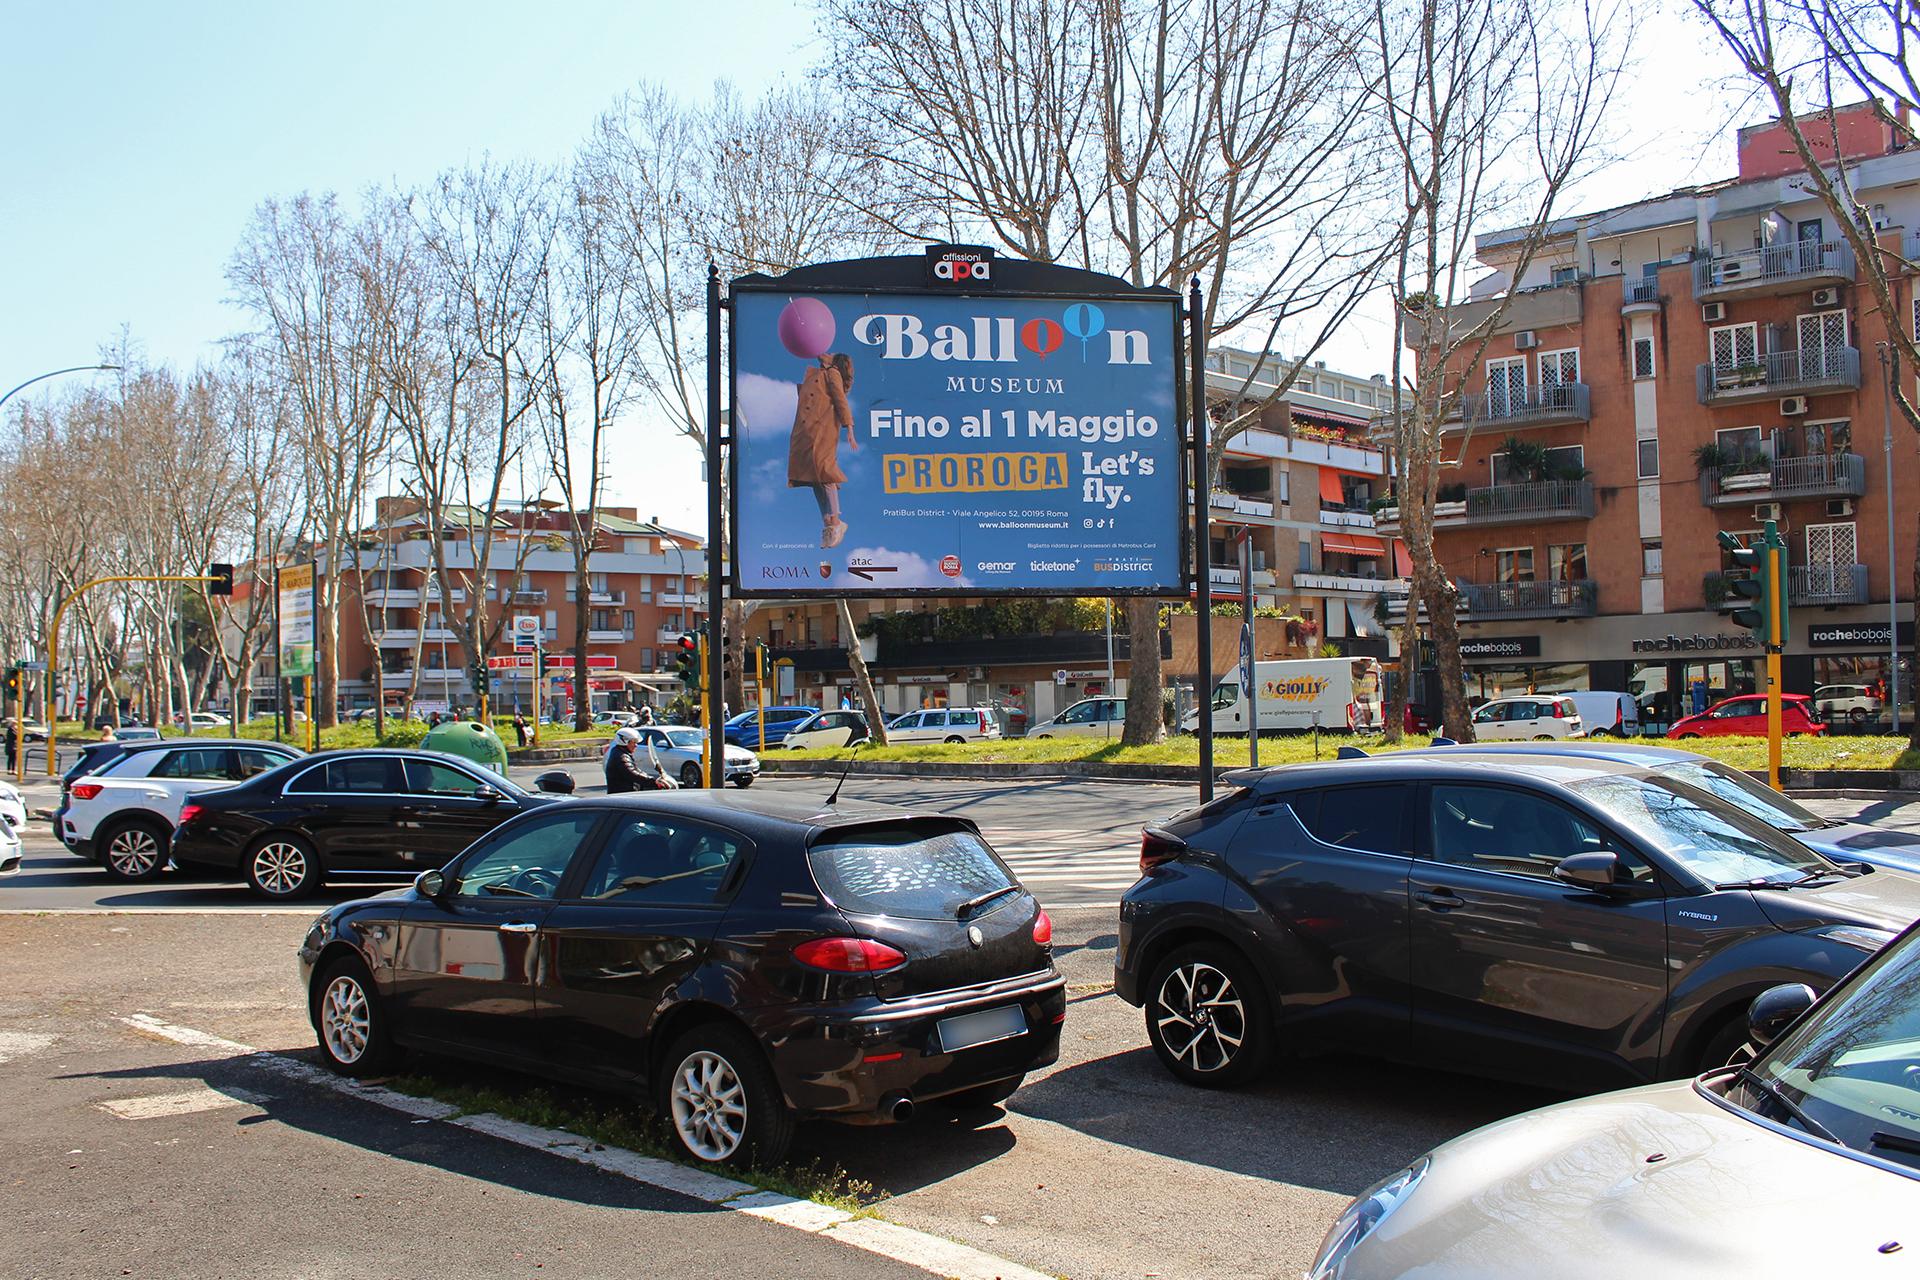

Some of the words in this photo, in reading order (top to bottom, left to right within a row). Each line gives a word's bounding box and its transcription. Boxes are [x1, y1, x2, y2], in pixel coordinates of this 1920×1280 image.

[942, 252, 981, 262] affissioni
[934, 261, 990, 282] apa
[852, 302, 1153, 365] Balloon
[946, 376, 1065, 395] MUSEUM
[870, 409, 950, 438] Fino
[961, 409, 992, 438] al
[1001, 410, 1016, 438] 1
[1028, 409, 1159, 443] Maggio
[1082, 450, 1155, 475] Let’s
[887, 455, 1063, 490] PROROGA
[1082, 477, 1132, 509] fly.
[883, 508, 916, 517] PratiBus
[917, 508, 945, 517] District
[952, 509, 972, 517] Viale
[973, 509, 1007, 518] Angelico
[978, 520, 1069, 529] www.balloonmuseum.it
[851, 558, 873, 566] atac
[1030, 560, 1076, 572] ticketone
[762, 565, 810, 579] ROMA
[520, 621, 536, 629] Esso
[1276, 681, 1322, 696] GIOLLY
[1678, 910, 1712, 921] HYBRID
